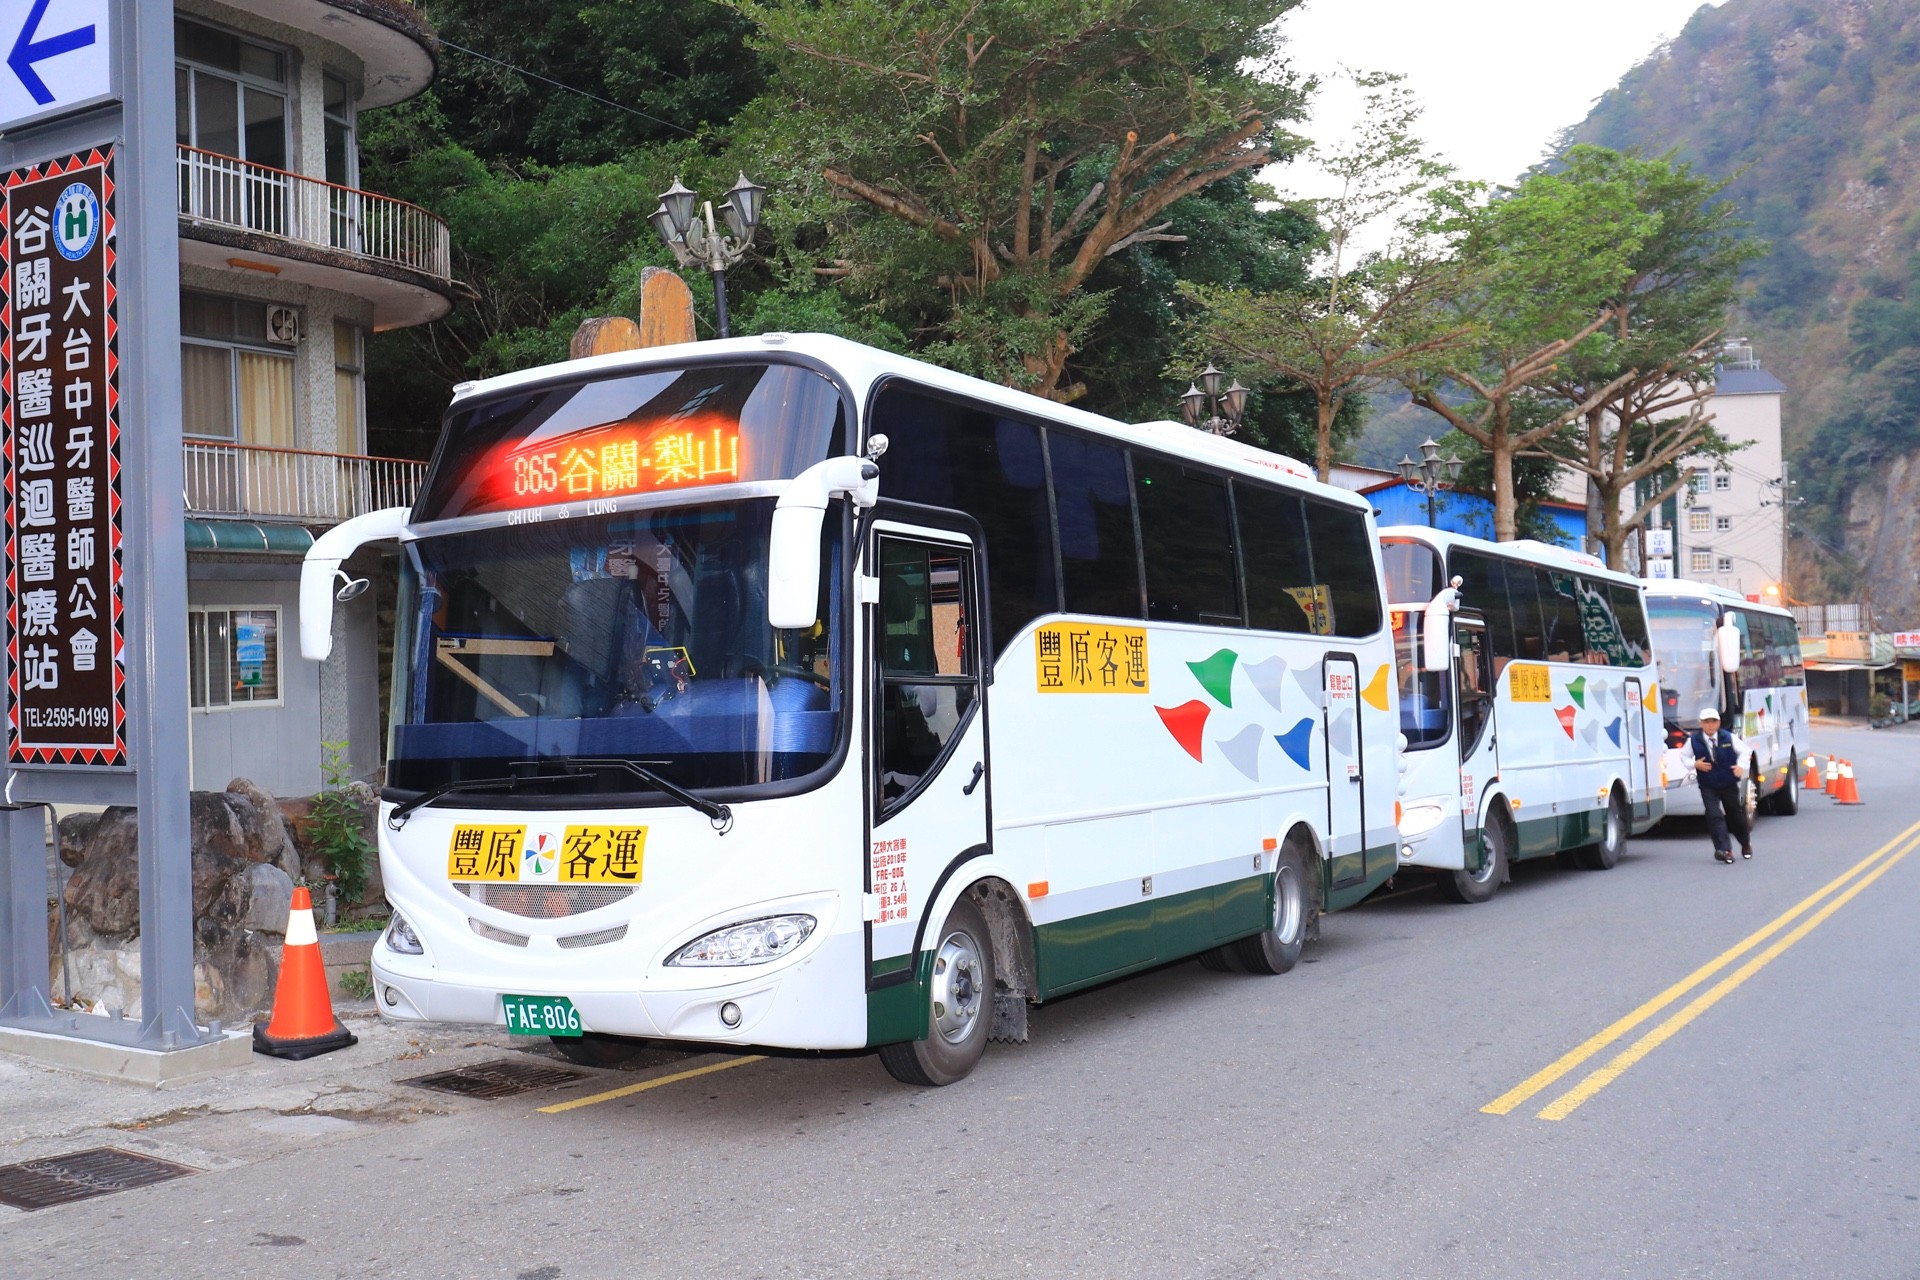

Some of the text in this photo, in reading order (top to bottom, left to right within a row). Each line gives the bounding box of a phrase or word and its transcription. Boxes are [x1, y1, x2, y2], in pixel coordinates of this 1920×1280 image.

[14, 205, 58, 691] 谷關牙醫巡迴醫療站
[62, 276, 98, 672] 大台中牙醫師公會
[507, 499, 617, 525] CHIUH LUNG
[1038, 630, 1147, 688] 豐原客運
[24, 707, 109, 728] TEL:2595-0199
[451, 827, 642, 880] 豐原 客運
[873, 838, 907, 855] 乙類大客車
